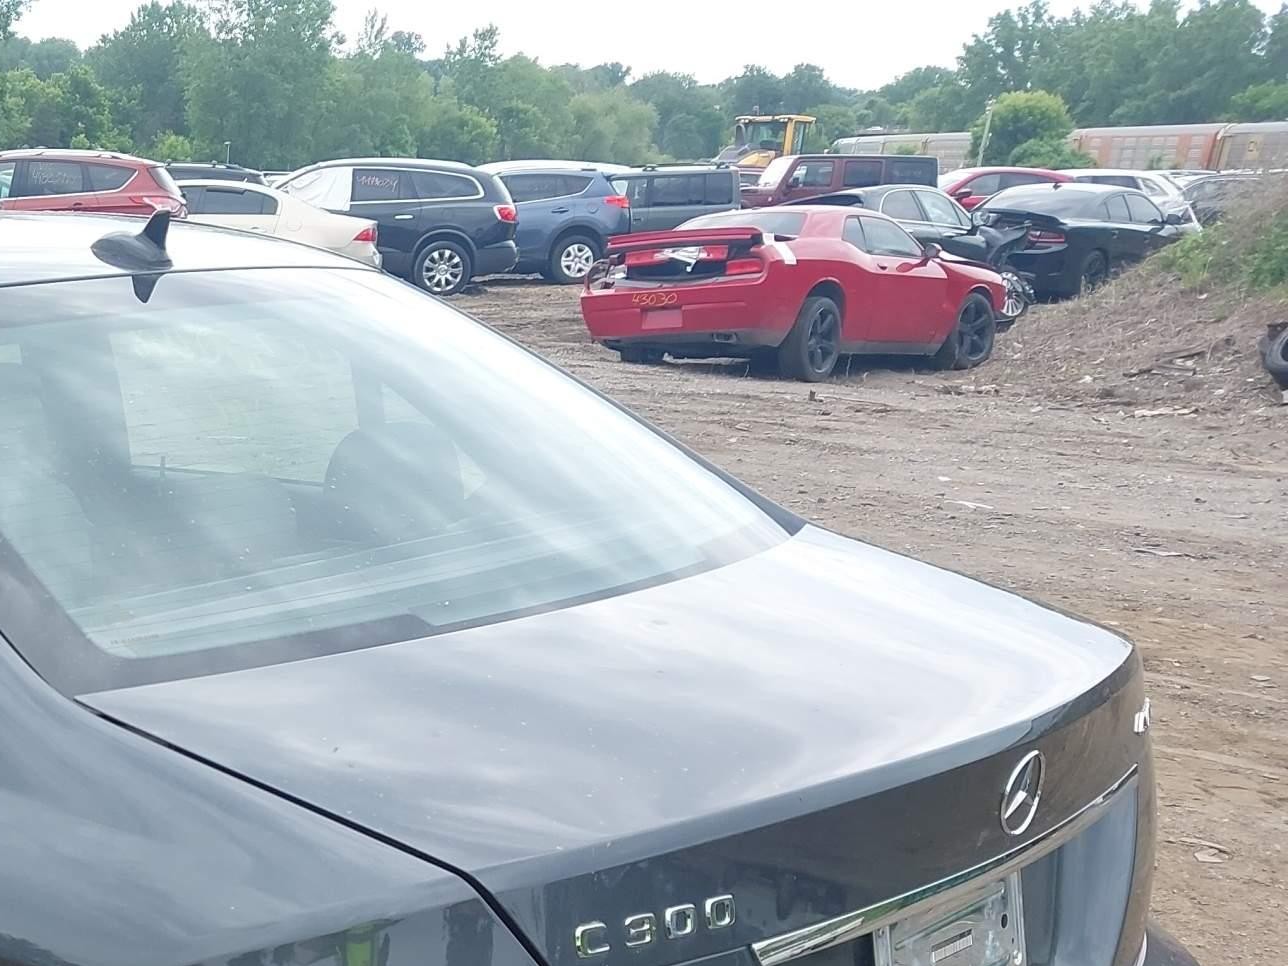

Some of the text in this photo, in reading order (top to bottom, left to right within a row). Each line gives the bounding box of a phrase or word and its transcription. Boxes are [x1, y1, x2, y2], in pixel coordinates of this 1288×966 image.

[632, 292, 678, 306] 43030
[574, 893, 736, 958] C 300
